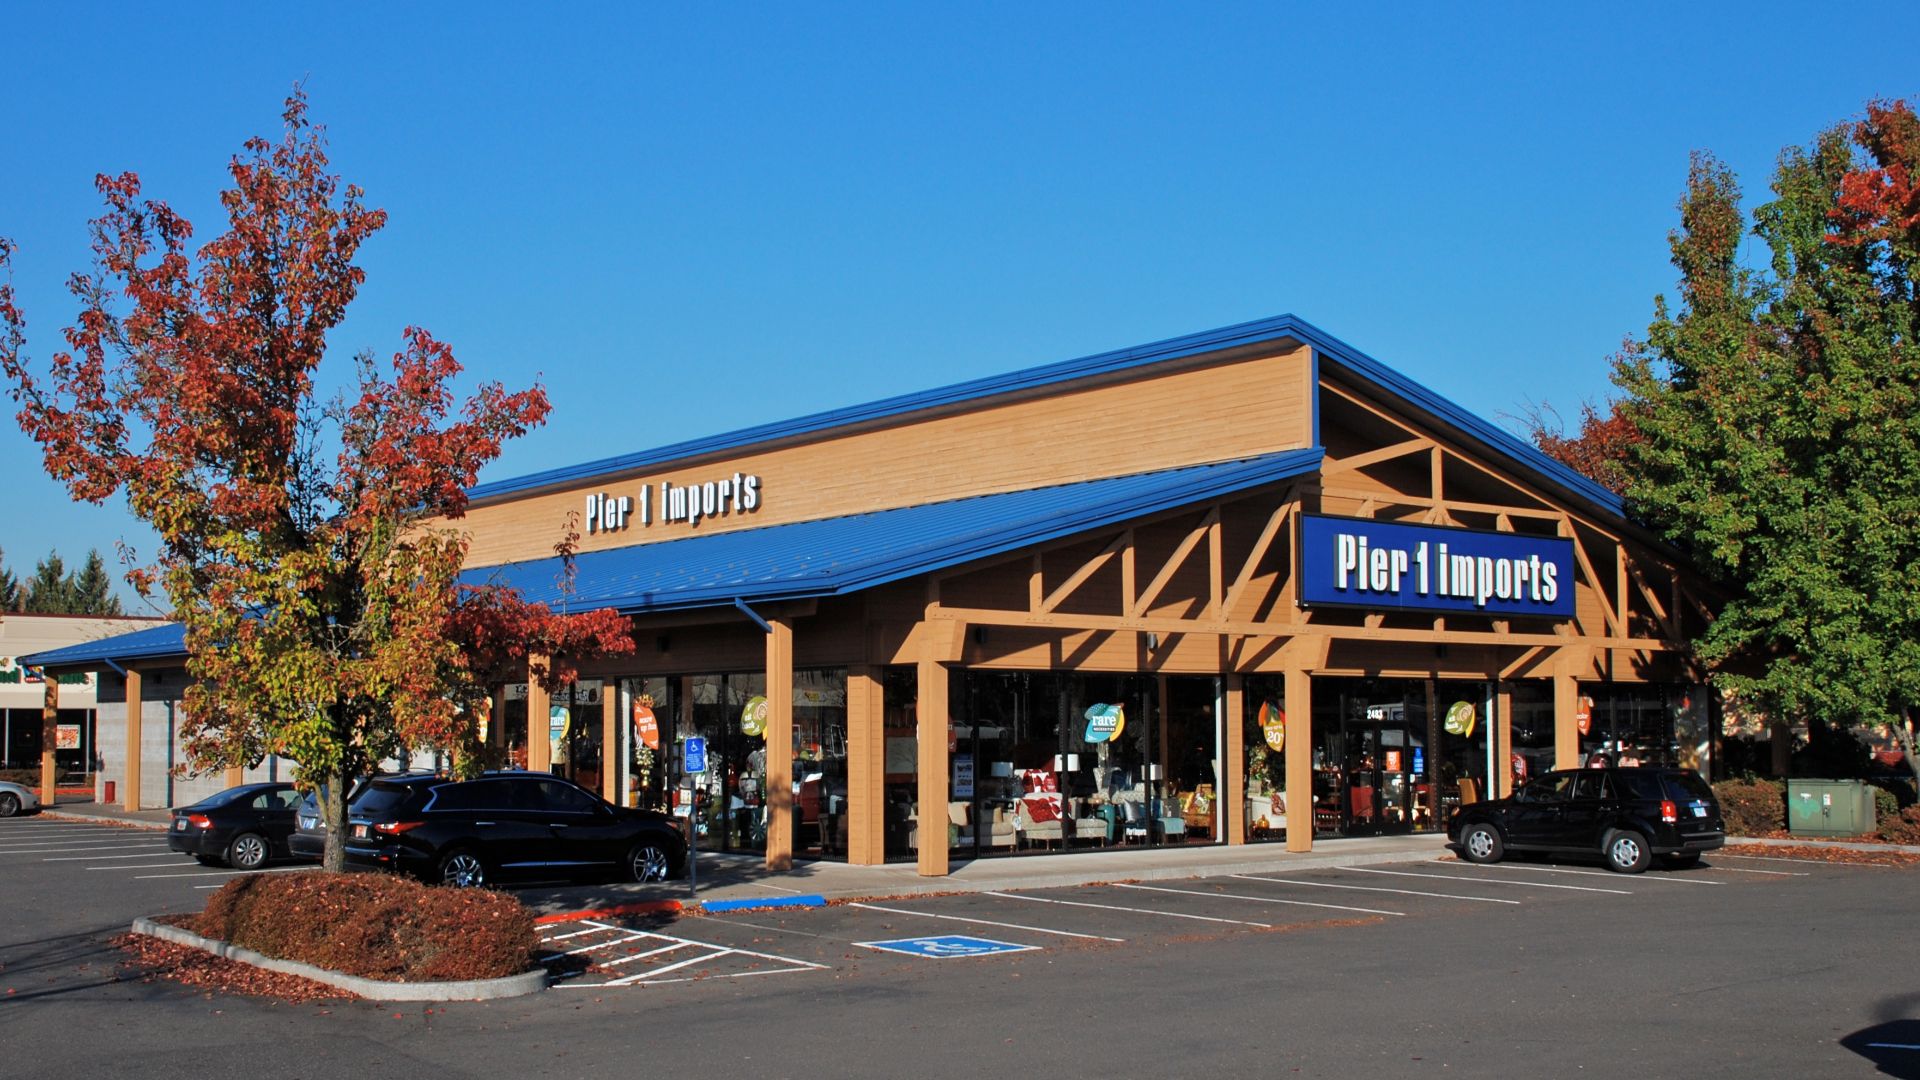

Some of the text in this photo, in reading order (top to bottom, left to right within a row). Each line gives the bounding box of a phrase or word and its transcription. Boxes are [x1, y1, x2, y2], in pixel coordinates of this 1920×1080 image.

[586, 472, 759, 532] Pier 1 imports
[1336, 533, 1558, 606] Pier 1 imports
[1092, 715, 1117, 726] rare
[1366, 709, 1384, 720] 2483
